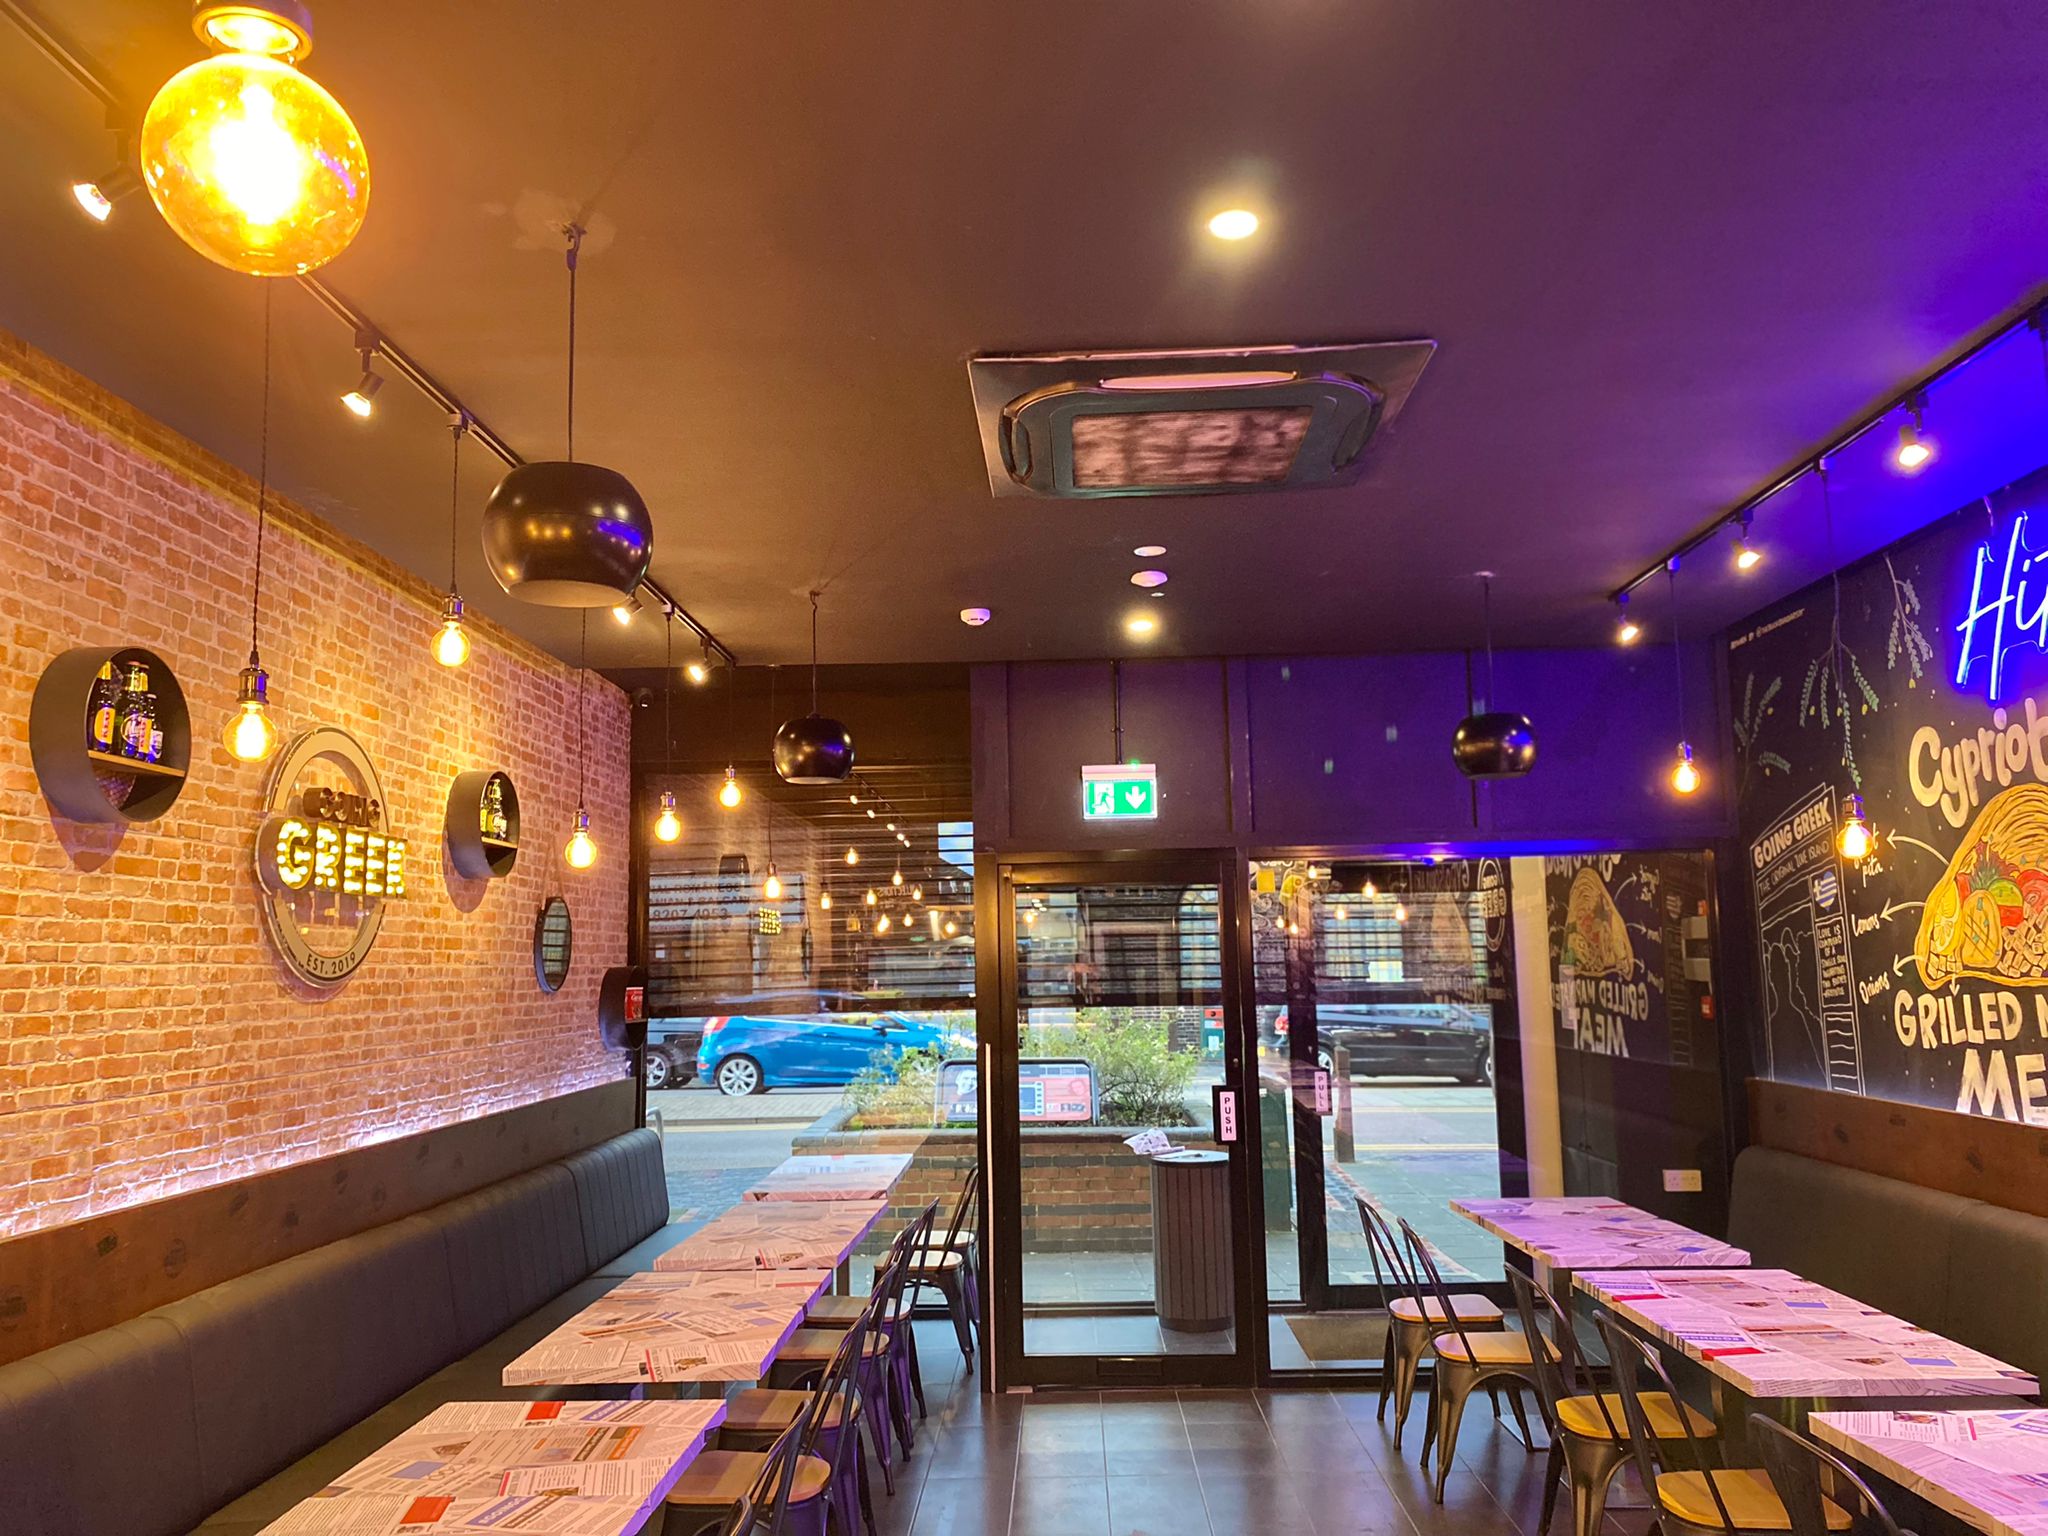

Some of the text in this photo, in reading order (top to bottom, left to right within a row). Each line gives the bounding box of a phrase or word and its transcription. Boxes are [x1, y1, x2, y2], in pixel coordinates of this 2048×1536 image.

[1753, 797, 1832, 869] GOING GREEK
[276, 817, 407, 898] GREEK
[1862, 854, 1883, 888] pita
[1833, 924, 1841, 936] IS
[306, 951, 356, 975] EST. 2019
[1858, 971, 1891, 1005] Onions
[1894, 989, 2023, 1049] GRILLED
[1318, 1075, 1326, 1107] PULL
[1223, 1096, 1233, 1134] PUSH
